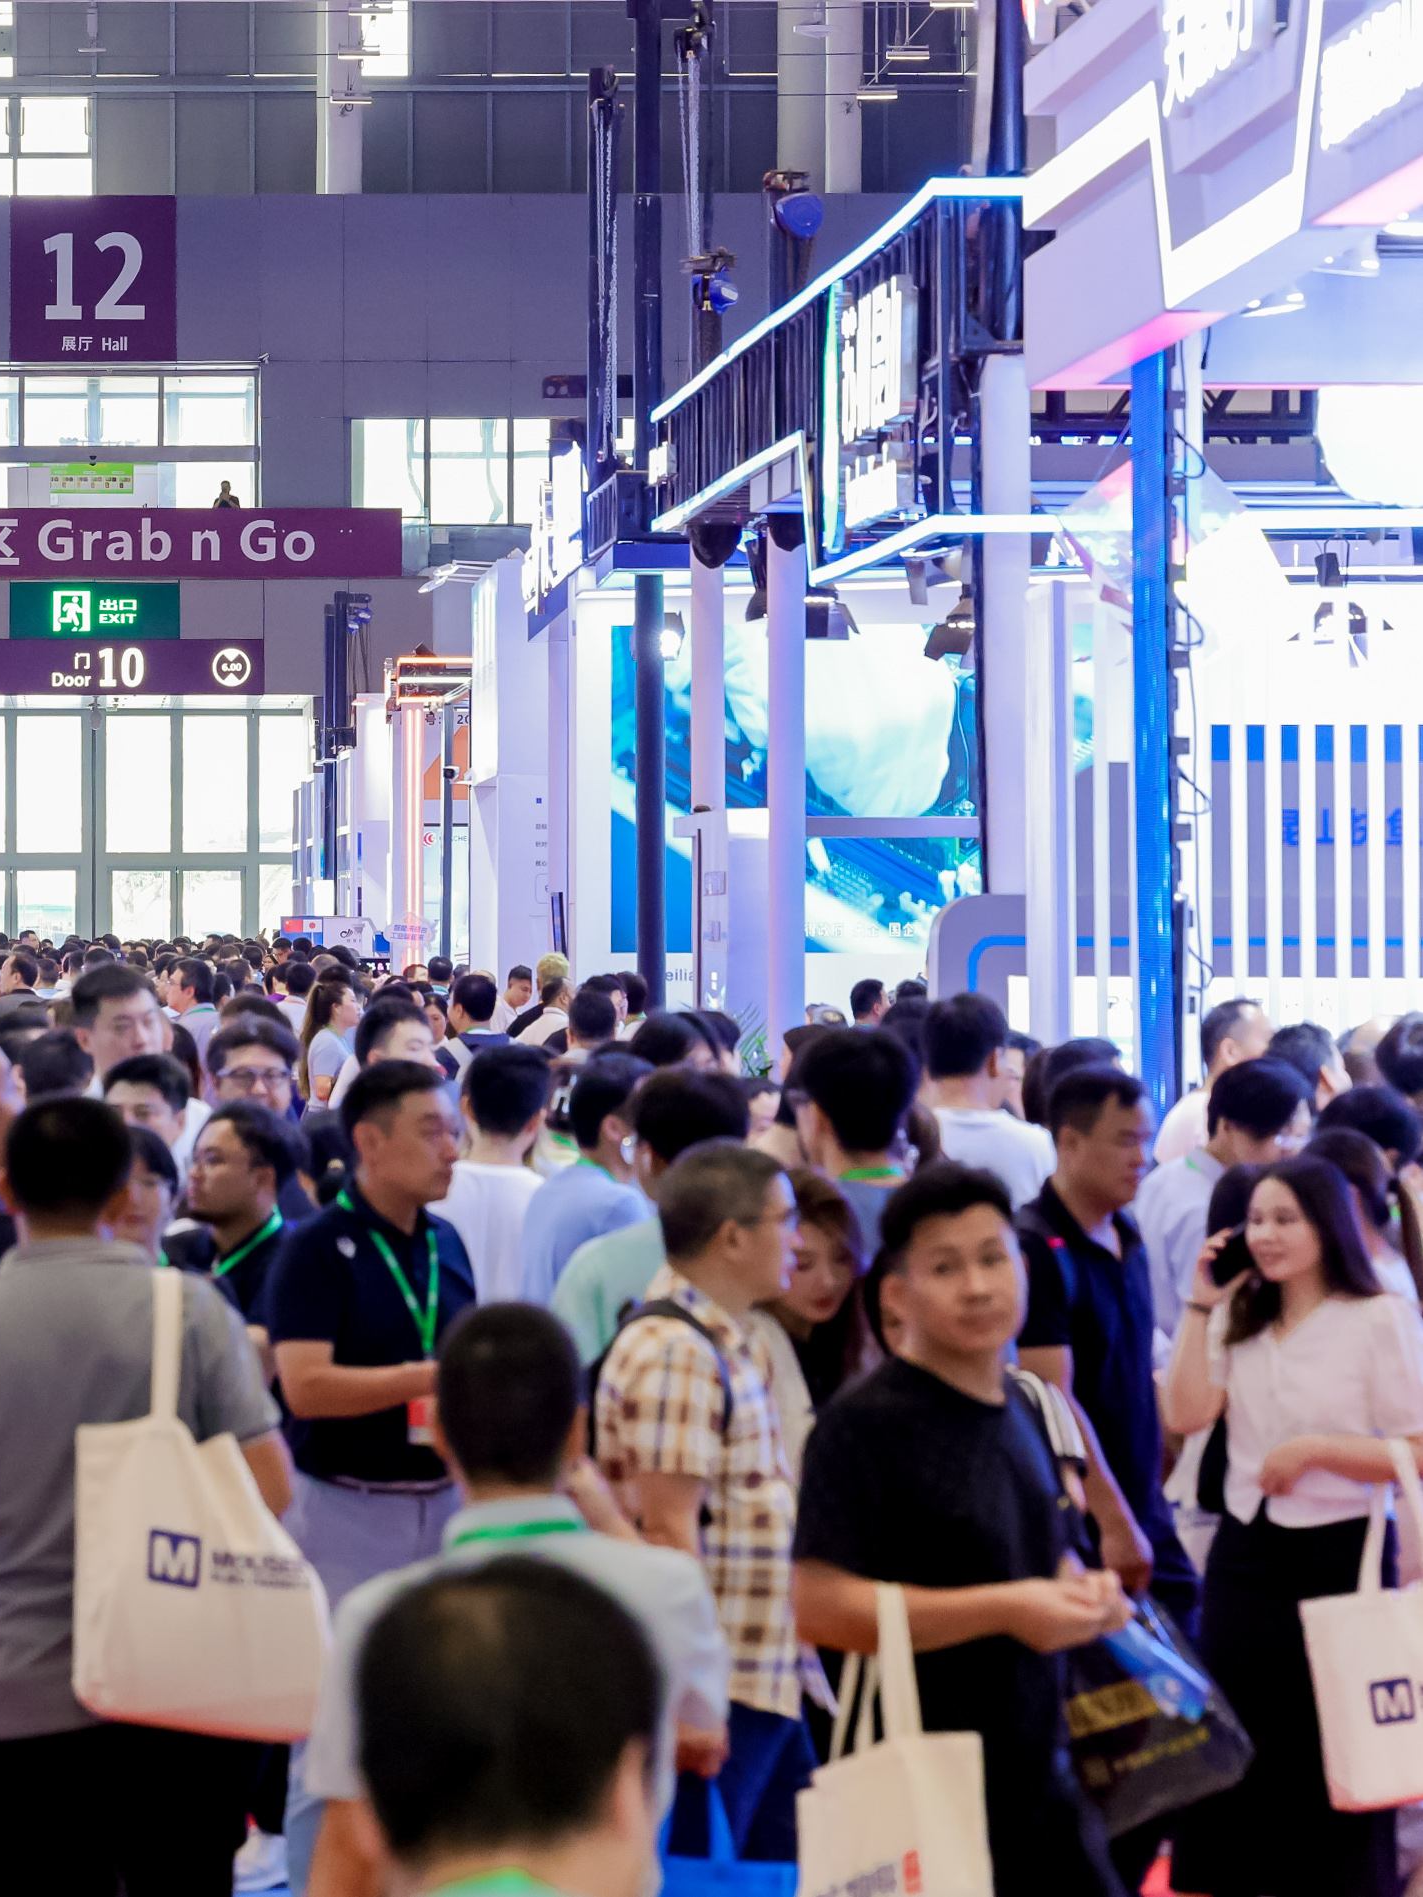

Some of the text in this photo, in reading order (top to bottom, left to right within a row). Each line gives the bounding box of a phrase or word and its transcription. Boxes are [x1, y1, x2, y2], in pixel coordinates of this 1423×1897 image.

[42, 231, 145, 320] 12
[61, 336, 128, 351] 展厅 Hall
[37, 518, 172, 562] Grab
[191, 531, 220, 562] n
[240, 519, 315, 562] Go
[99, 599, 138, 611] 出口
[99, 613, 137, 625] EXIT
[74, 652, 91, 670] 门
[98, 648, 145, 688] 10
[221, 661, 243, 673] 6.00
[51, 672, 92, 688] Door
